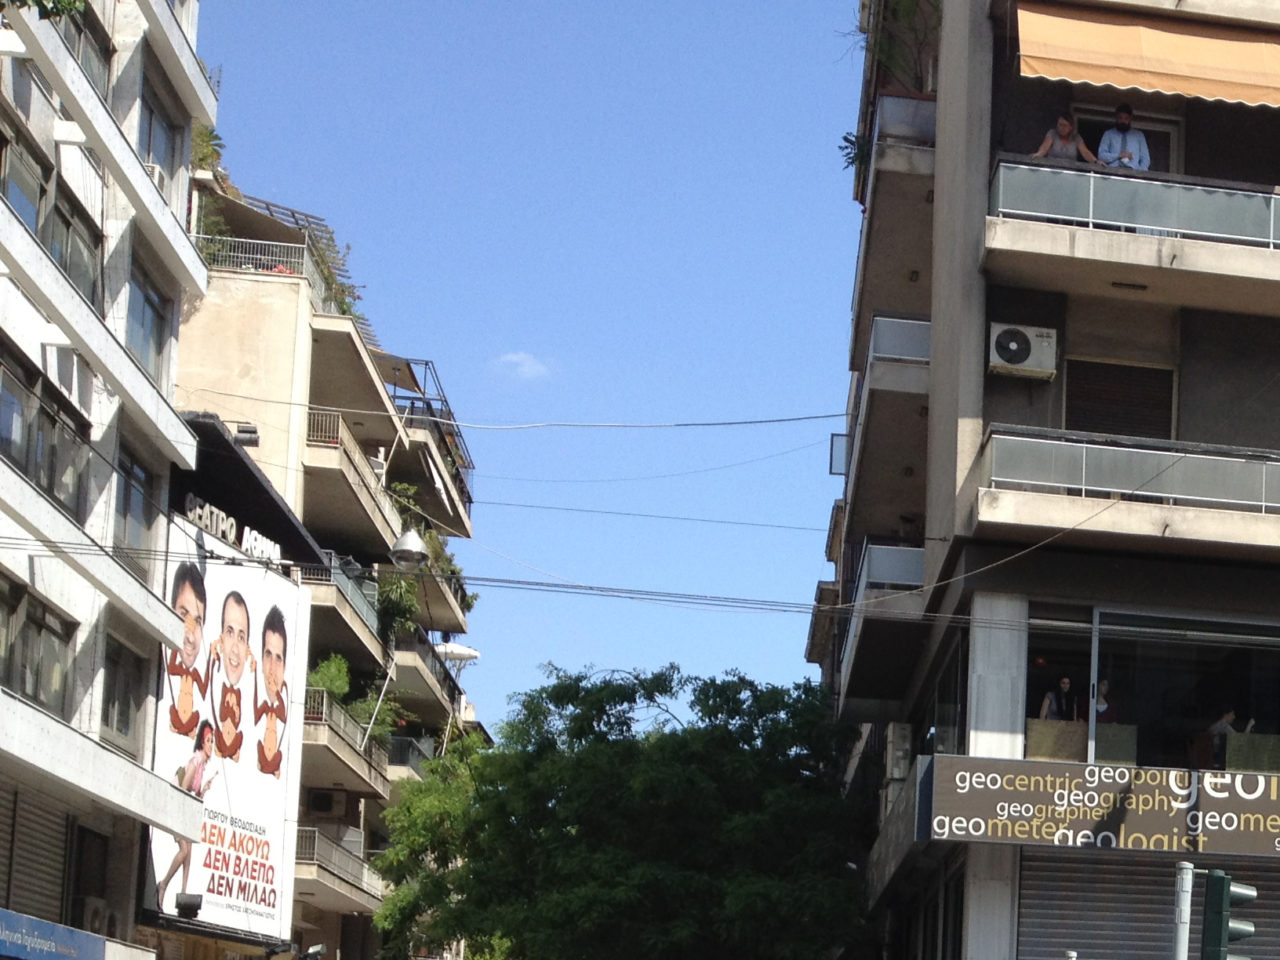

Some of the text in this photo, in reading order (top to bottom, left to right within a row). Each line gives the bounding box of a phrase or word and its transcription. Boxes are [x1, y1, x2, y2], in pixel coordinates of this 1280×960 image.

[955, 770, 1083, 793] geocentric
[996, 801, 1108, 822] geographer
[201, 821, 270, 861] ΔΕΝ ΑΚΟΥΩ
[1054, 824, 1208, 852] geologist
[203, 847, 275, 885] ΔΕΝ ΒΛΕΠΩ
[206, 873, 277, 909] ΔΕΝ ΜΙΛΑΩ
